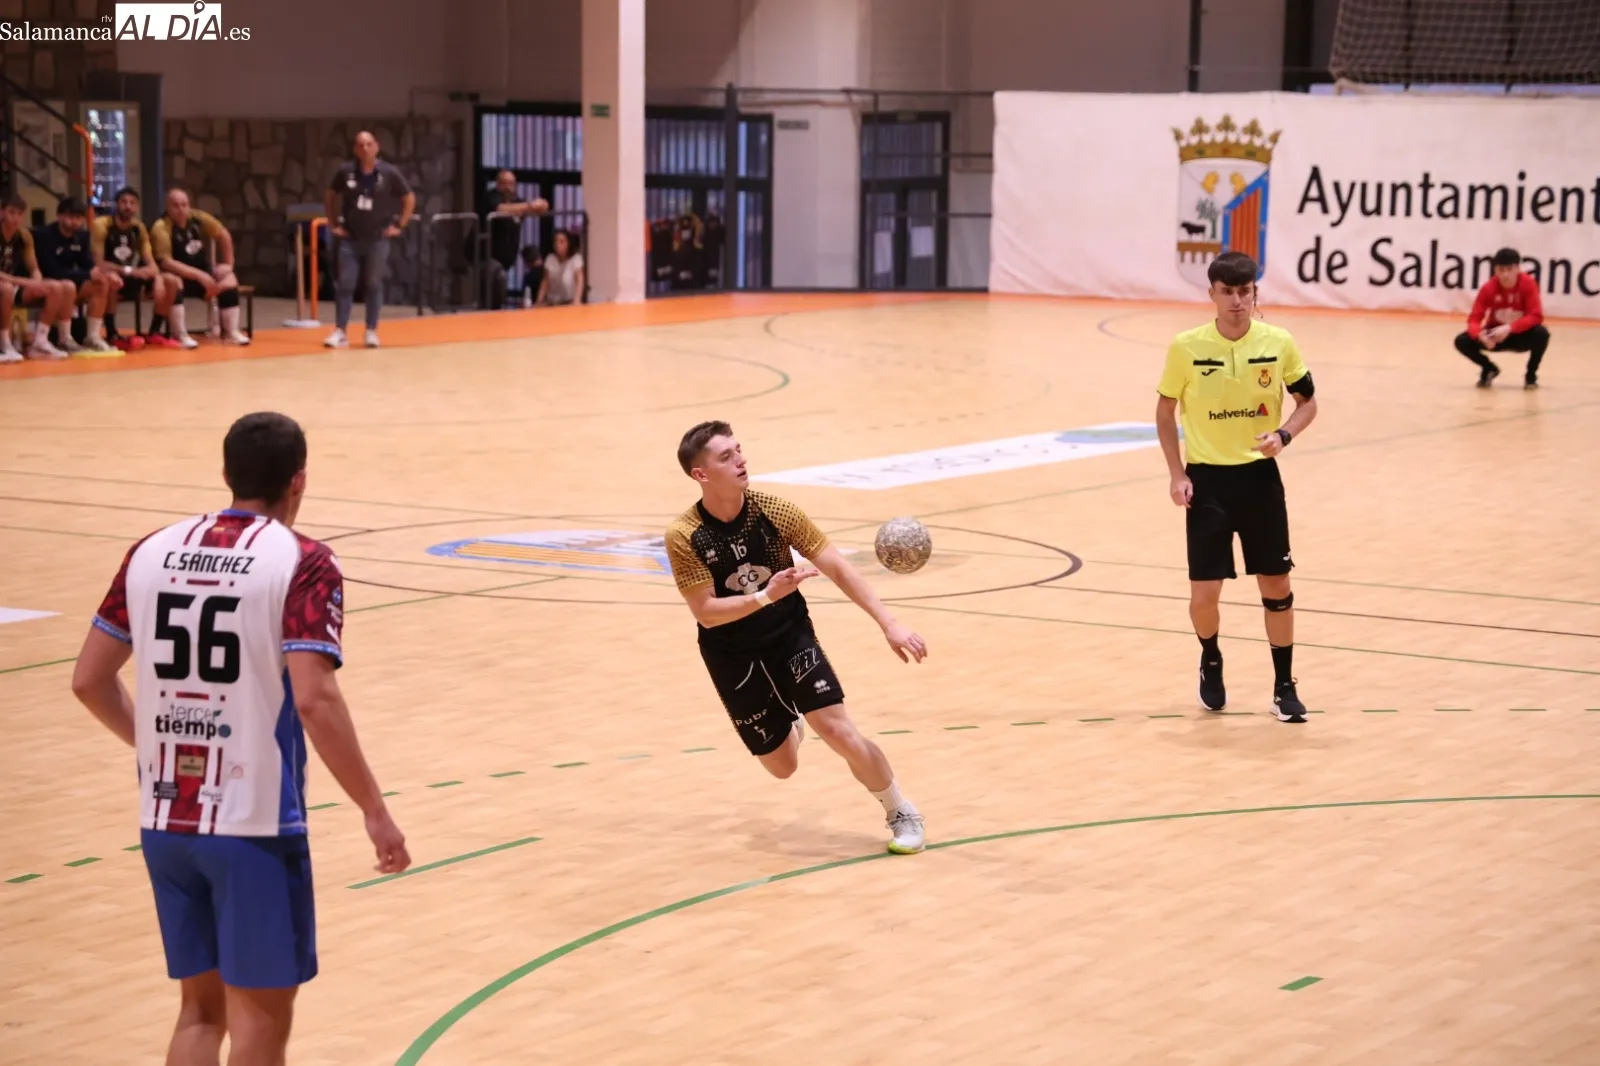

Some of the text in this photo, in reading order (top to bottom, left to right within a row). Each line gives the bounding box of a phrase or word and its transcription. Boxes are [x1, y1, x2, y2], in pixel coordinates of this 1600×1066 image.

[1297, 235, 1349, 285] de
[1208, 408, 1256, 420] helvetia
[730, 539, 748, 560] 16
[738, 569, 759, 587] CG
[153, 592, 242, 684] 56
[155, 714, 232, 741] tiempo
